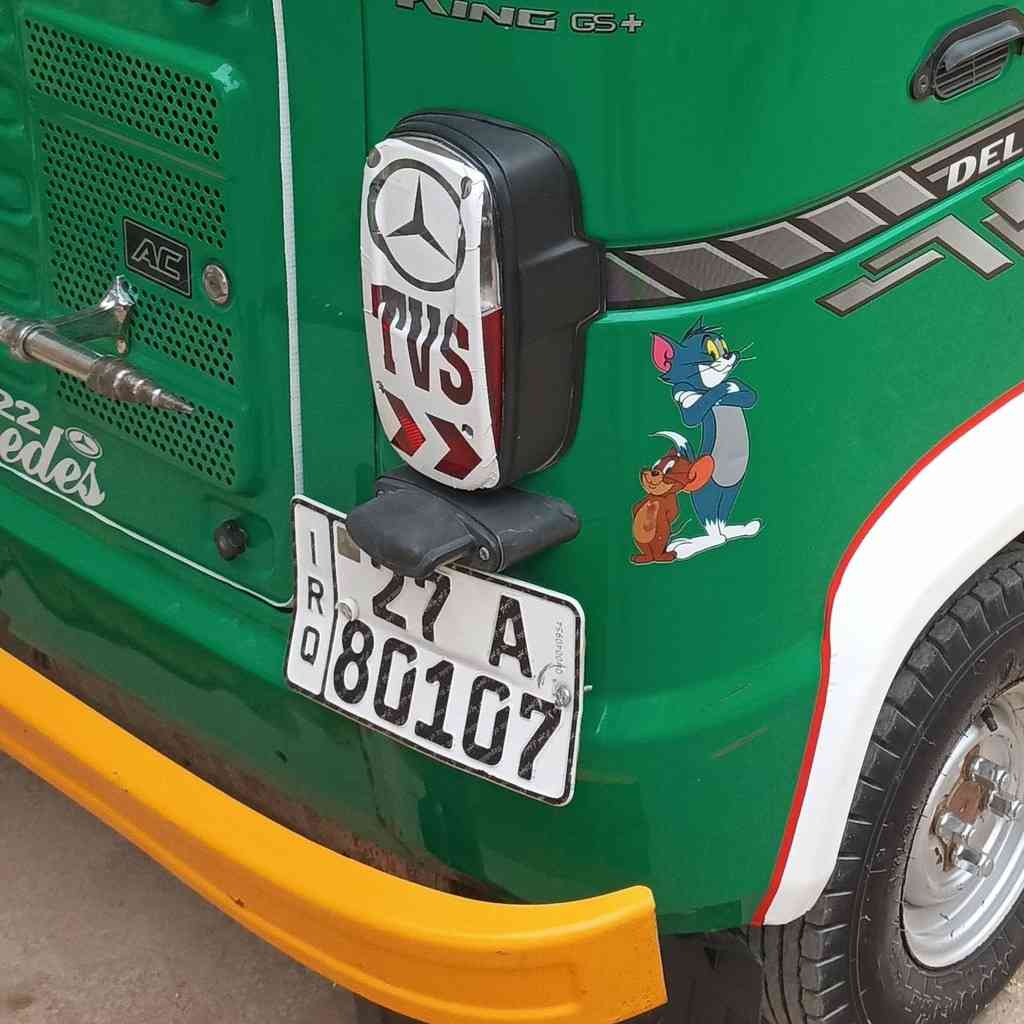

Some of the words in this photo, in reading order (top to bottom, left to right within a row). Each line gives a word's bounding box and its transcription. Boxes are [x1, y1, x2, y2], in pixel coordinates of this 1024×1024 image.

[131, 238, 183, 281] AC
[371, 284, 473, 405] TVS
[371, 556, 451, 643] 27
[488, 594, 533, 678] A
[333, 619, 562, 781] 80107
